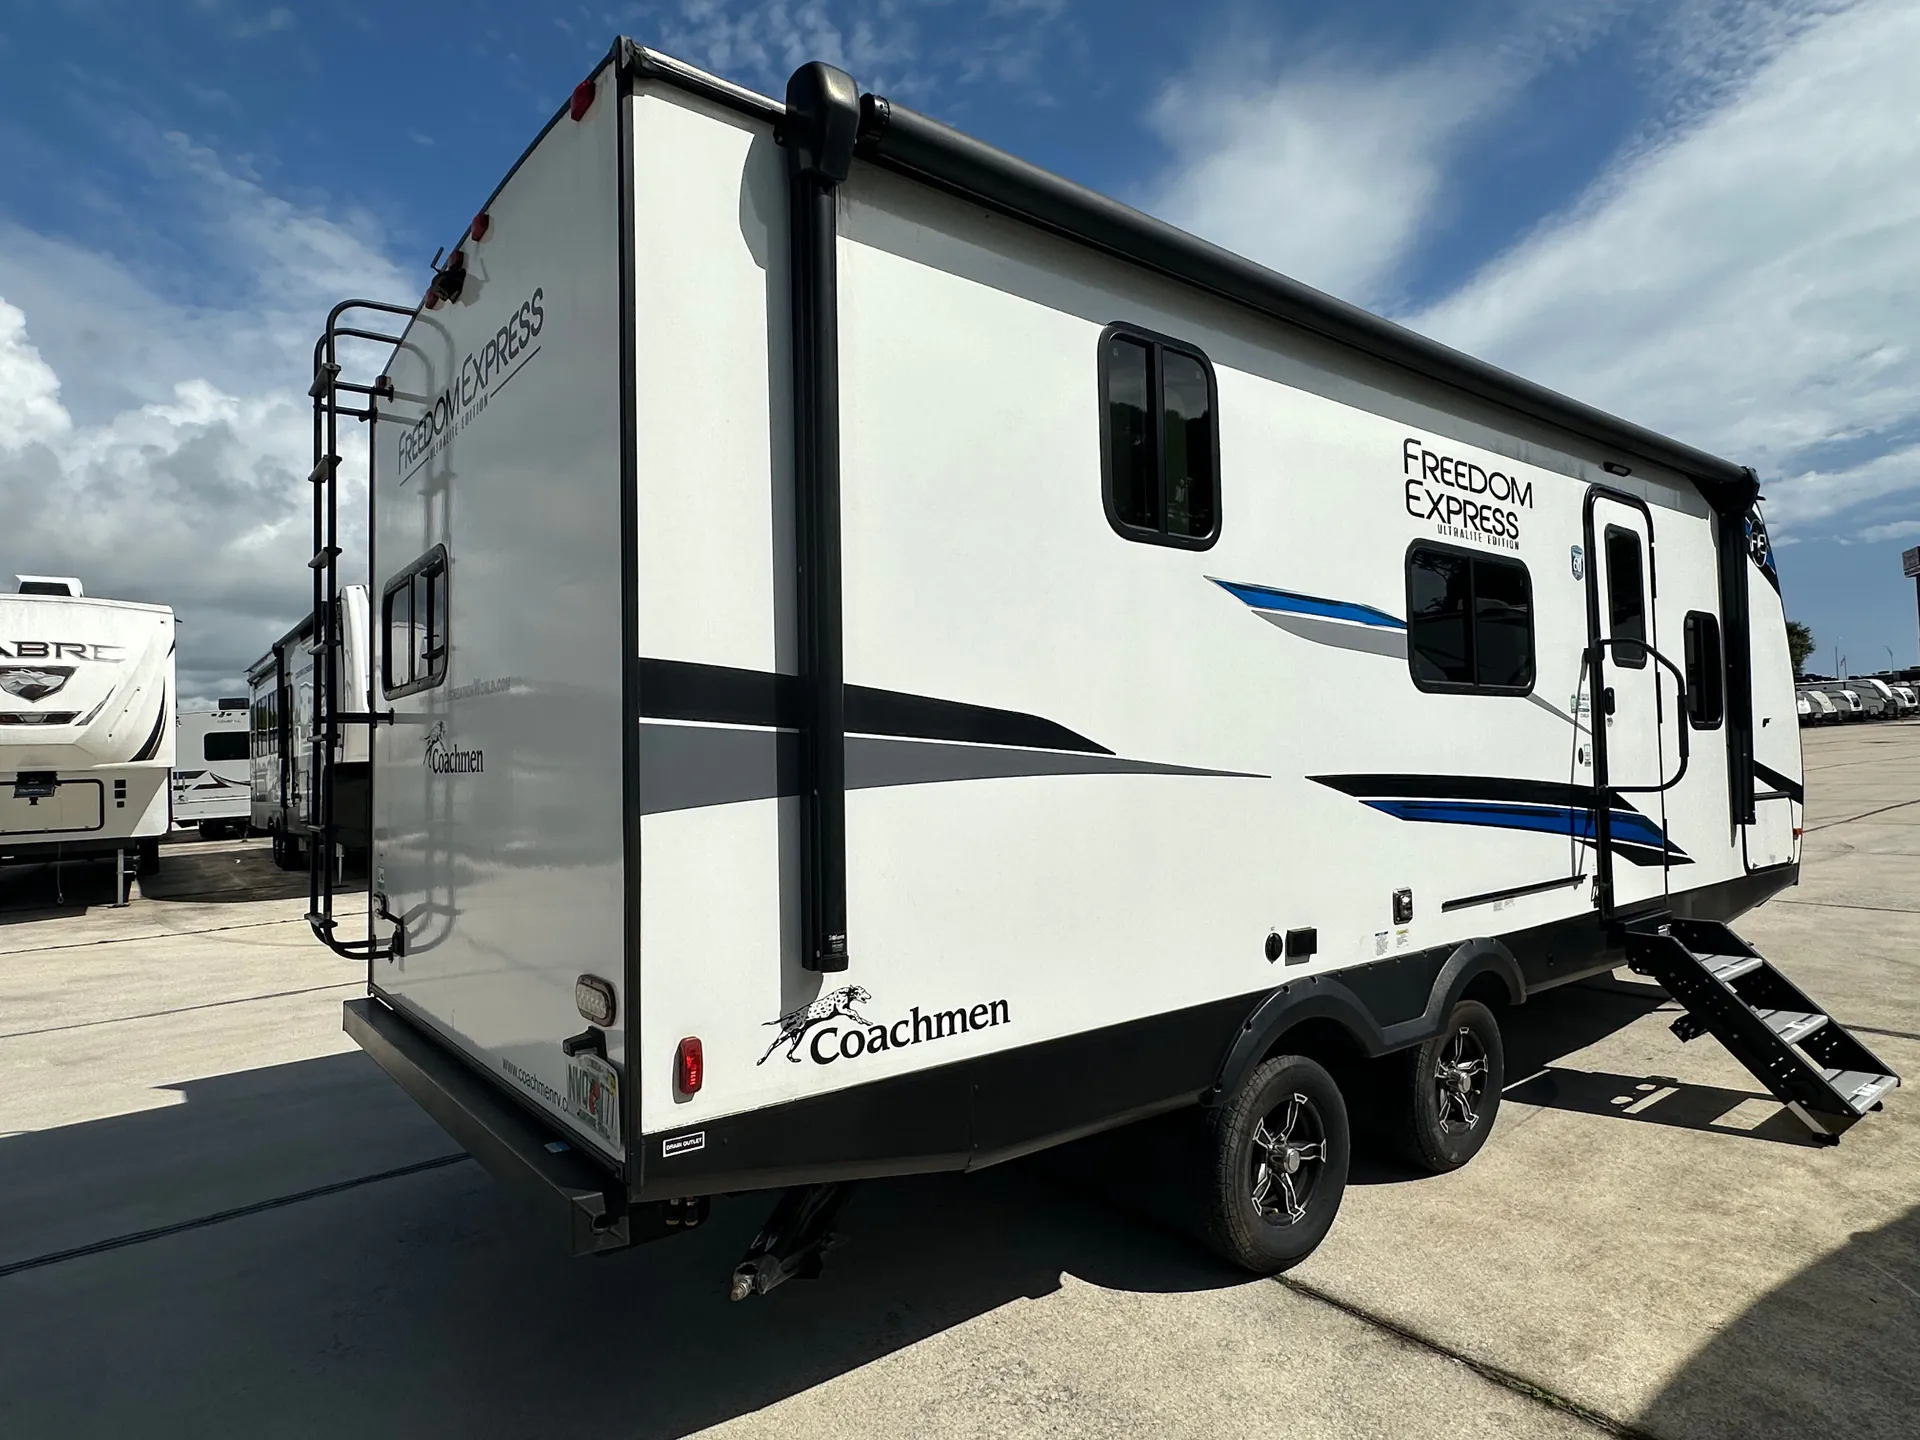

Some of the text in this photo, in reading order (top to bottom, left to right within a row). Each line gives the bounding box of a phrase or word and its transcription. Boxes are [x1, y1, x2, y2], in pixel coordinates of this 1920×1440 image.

[398, 287, 544, 475] FREEDOM EXPRESS
[1403, 437, 1533, 509] FREEDOM
[1405, 478, 1520, 540] EXPRESS
[1437, 523, 1520, 550] ULTRALITE EDITION
[432, 744, 484, 773] Coachmen
[810, 998, 1011, 1065] Coachmen
[683, 1137, 702, 1147] OUTLET
